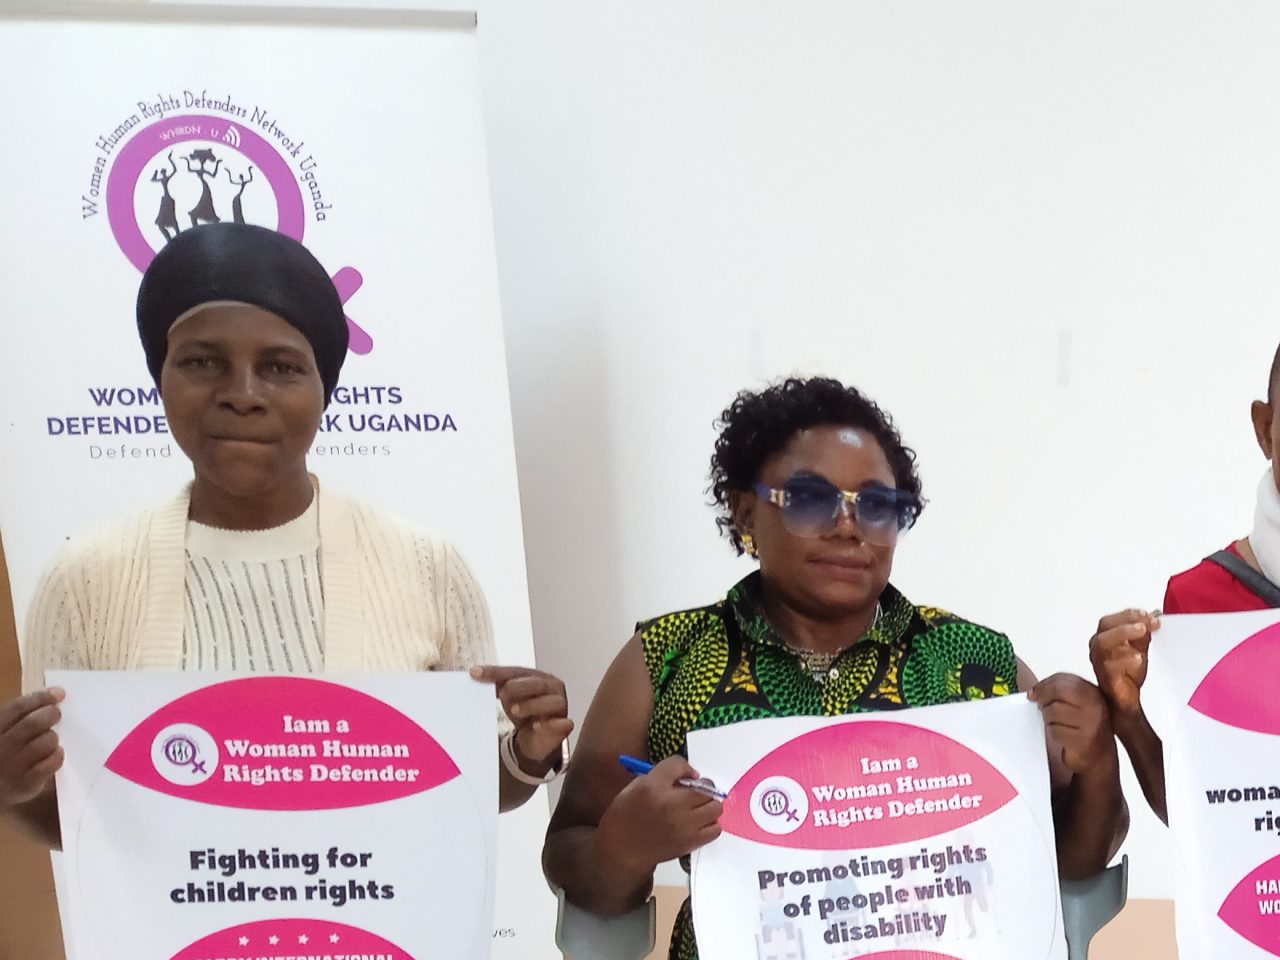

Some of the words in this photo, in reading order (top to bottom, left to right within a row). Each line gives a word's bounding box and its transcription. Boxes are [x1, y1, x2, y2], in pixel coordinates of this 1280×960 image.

[82, 144, 106, 220] Women
[96, 114, 141, 157] Human
[137, 94, 180, 121] Rights
[184, 89, 248, 118] Defenders
[249, 105, 301, 159] Network
[300, 155, 332, 222] Uganda
[46, 415, 168, 435] DEFENDE
[348, 413, 457, 432] UGANDA
[89, 443, 171, 460] Defend
[305, 441, 391, 456] enders
[224, 739, 316, 758] Woman
[322, 741, 409, 758] Human
[223, 765, 303, 785] Rights
[309, 765, 419, 783] Defender
[812, 782, 892, 803] Woman
[897, 771, 972, 794] Human
[813, 806, 883, 829] Rights
[888, 793, 983, 818] Defender
[190, 849, 319, 875] Fighting
[327, 848, 372, 868] for
[758, 855, 902, 889] Promoting
[909, 843, 987, 874] rights
[170, 882, 300, 903] children
[305, 881, 394, 906] rights
[783, 896, 811, 918] of
[818, 886, 908, 920] people
[916, 876, 972, 900] with
[823, 910, 947, 945] disability
